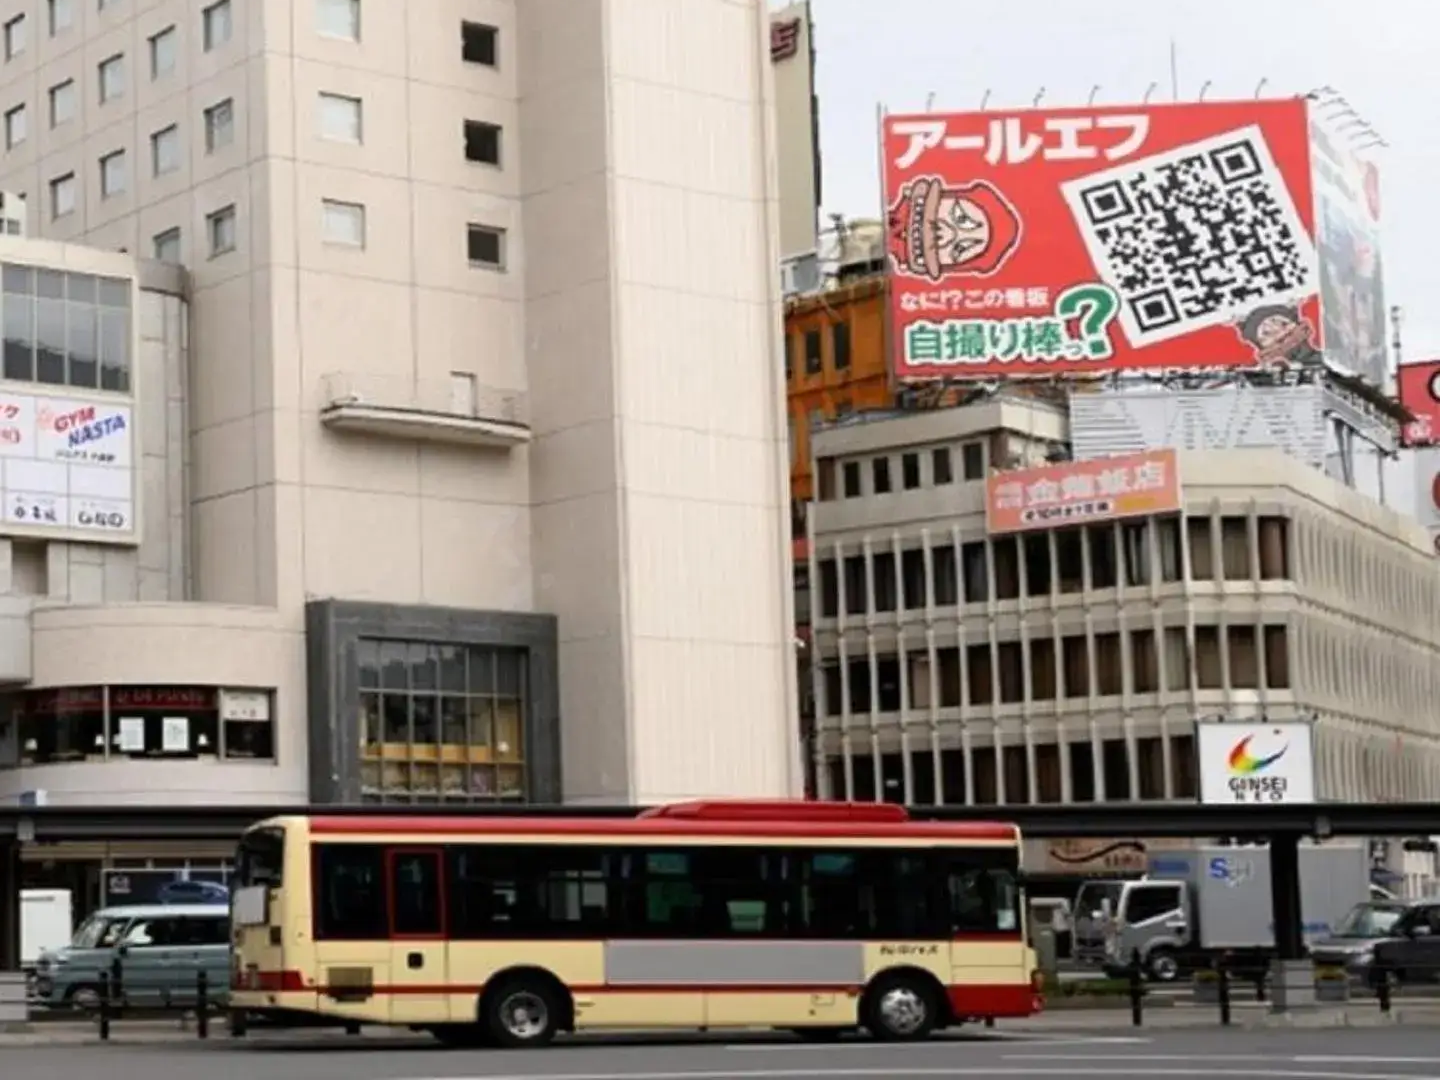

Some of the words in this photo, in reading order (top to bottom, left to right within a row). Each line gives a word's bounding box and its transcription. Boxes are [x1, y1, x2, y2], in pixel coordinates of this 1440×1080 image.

[891, 114, 1151, 170] アールエフ
[54, 406, 96, 433] GYM
[68, 415, 127, 448] NASTA
[1228, 776, 1288, 793] GINSEI
